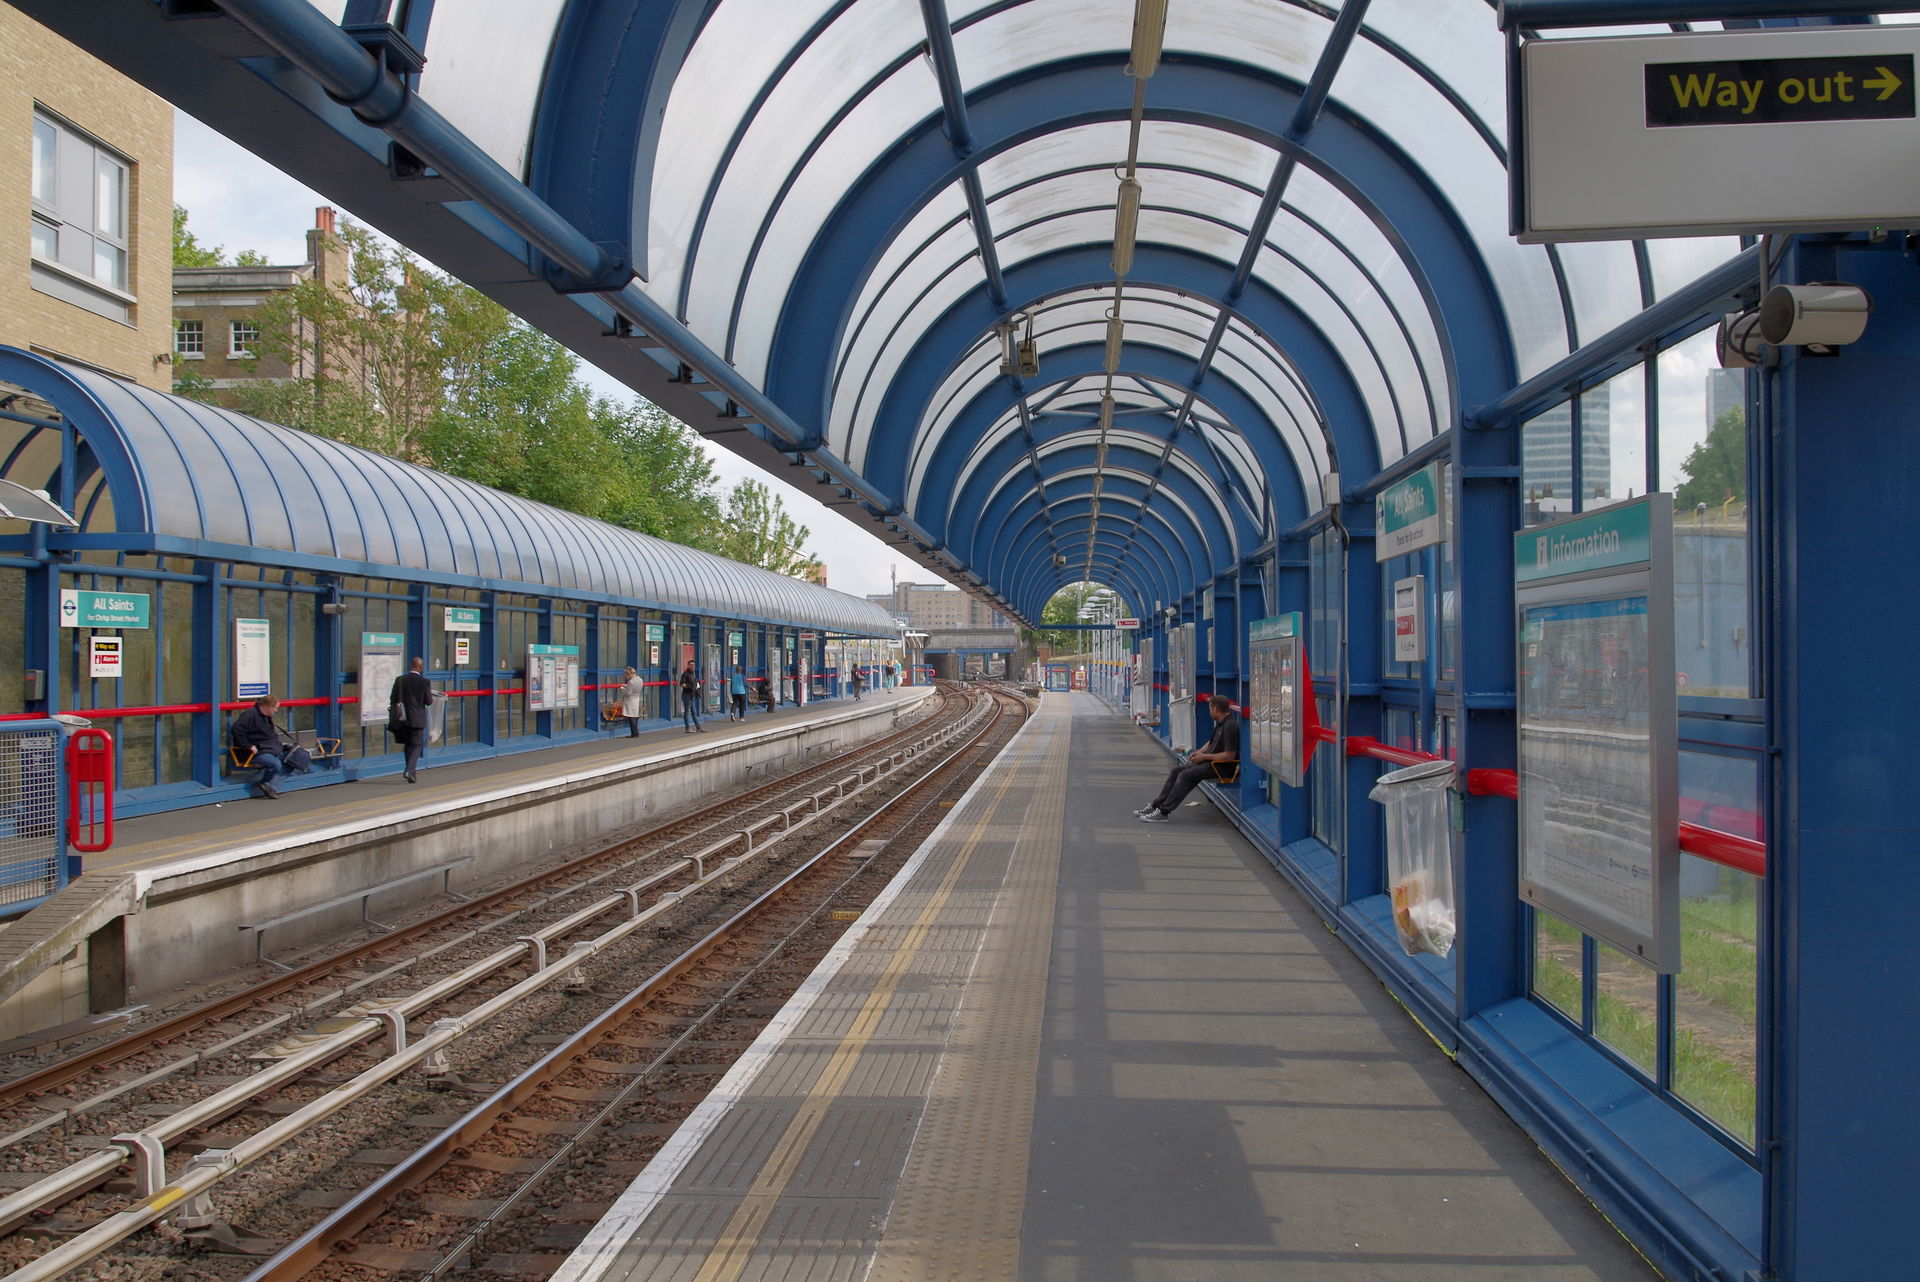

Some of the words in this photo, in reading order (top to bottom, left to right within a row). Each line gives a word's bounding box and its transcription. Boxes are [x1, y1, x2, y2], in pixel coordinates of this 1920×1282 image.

[1669, 73, 1764, 114] Way
[1778, 71, 1854, 104] out
[1394, 492, 1404, 517] All
[1404, 484, 1425, 513] Saints
[1550, 526, 1619, 564] Information
[94, 598, 106, 610] All
[109, 599, 134, 611] Saints
